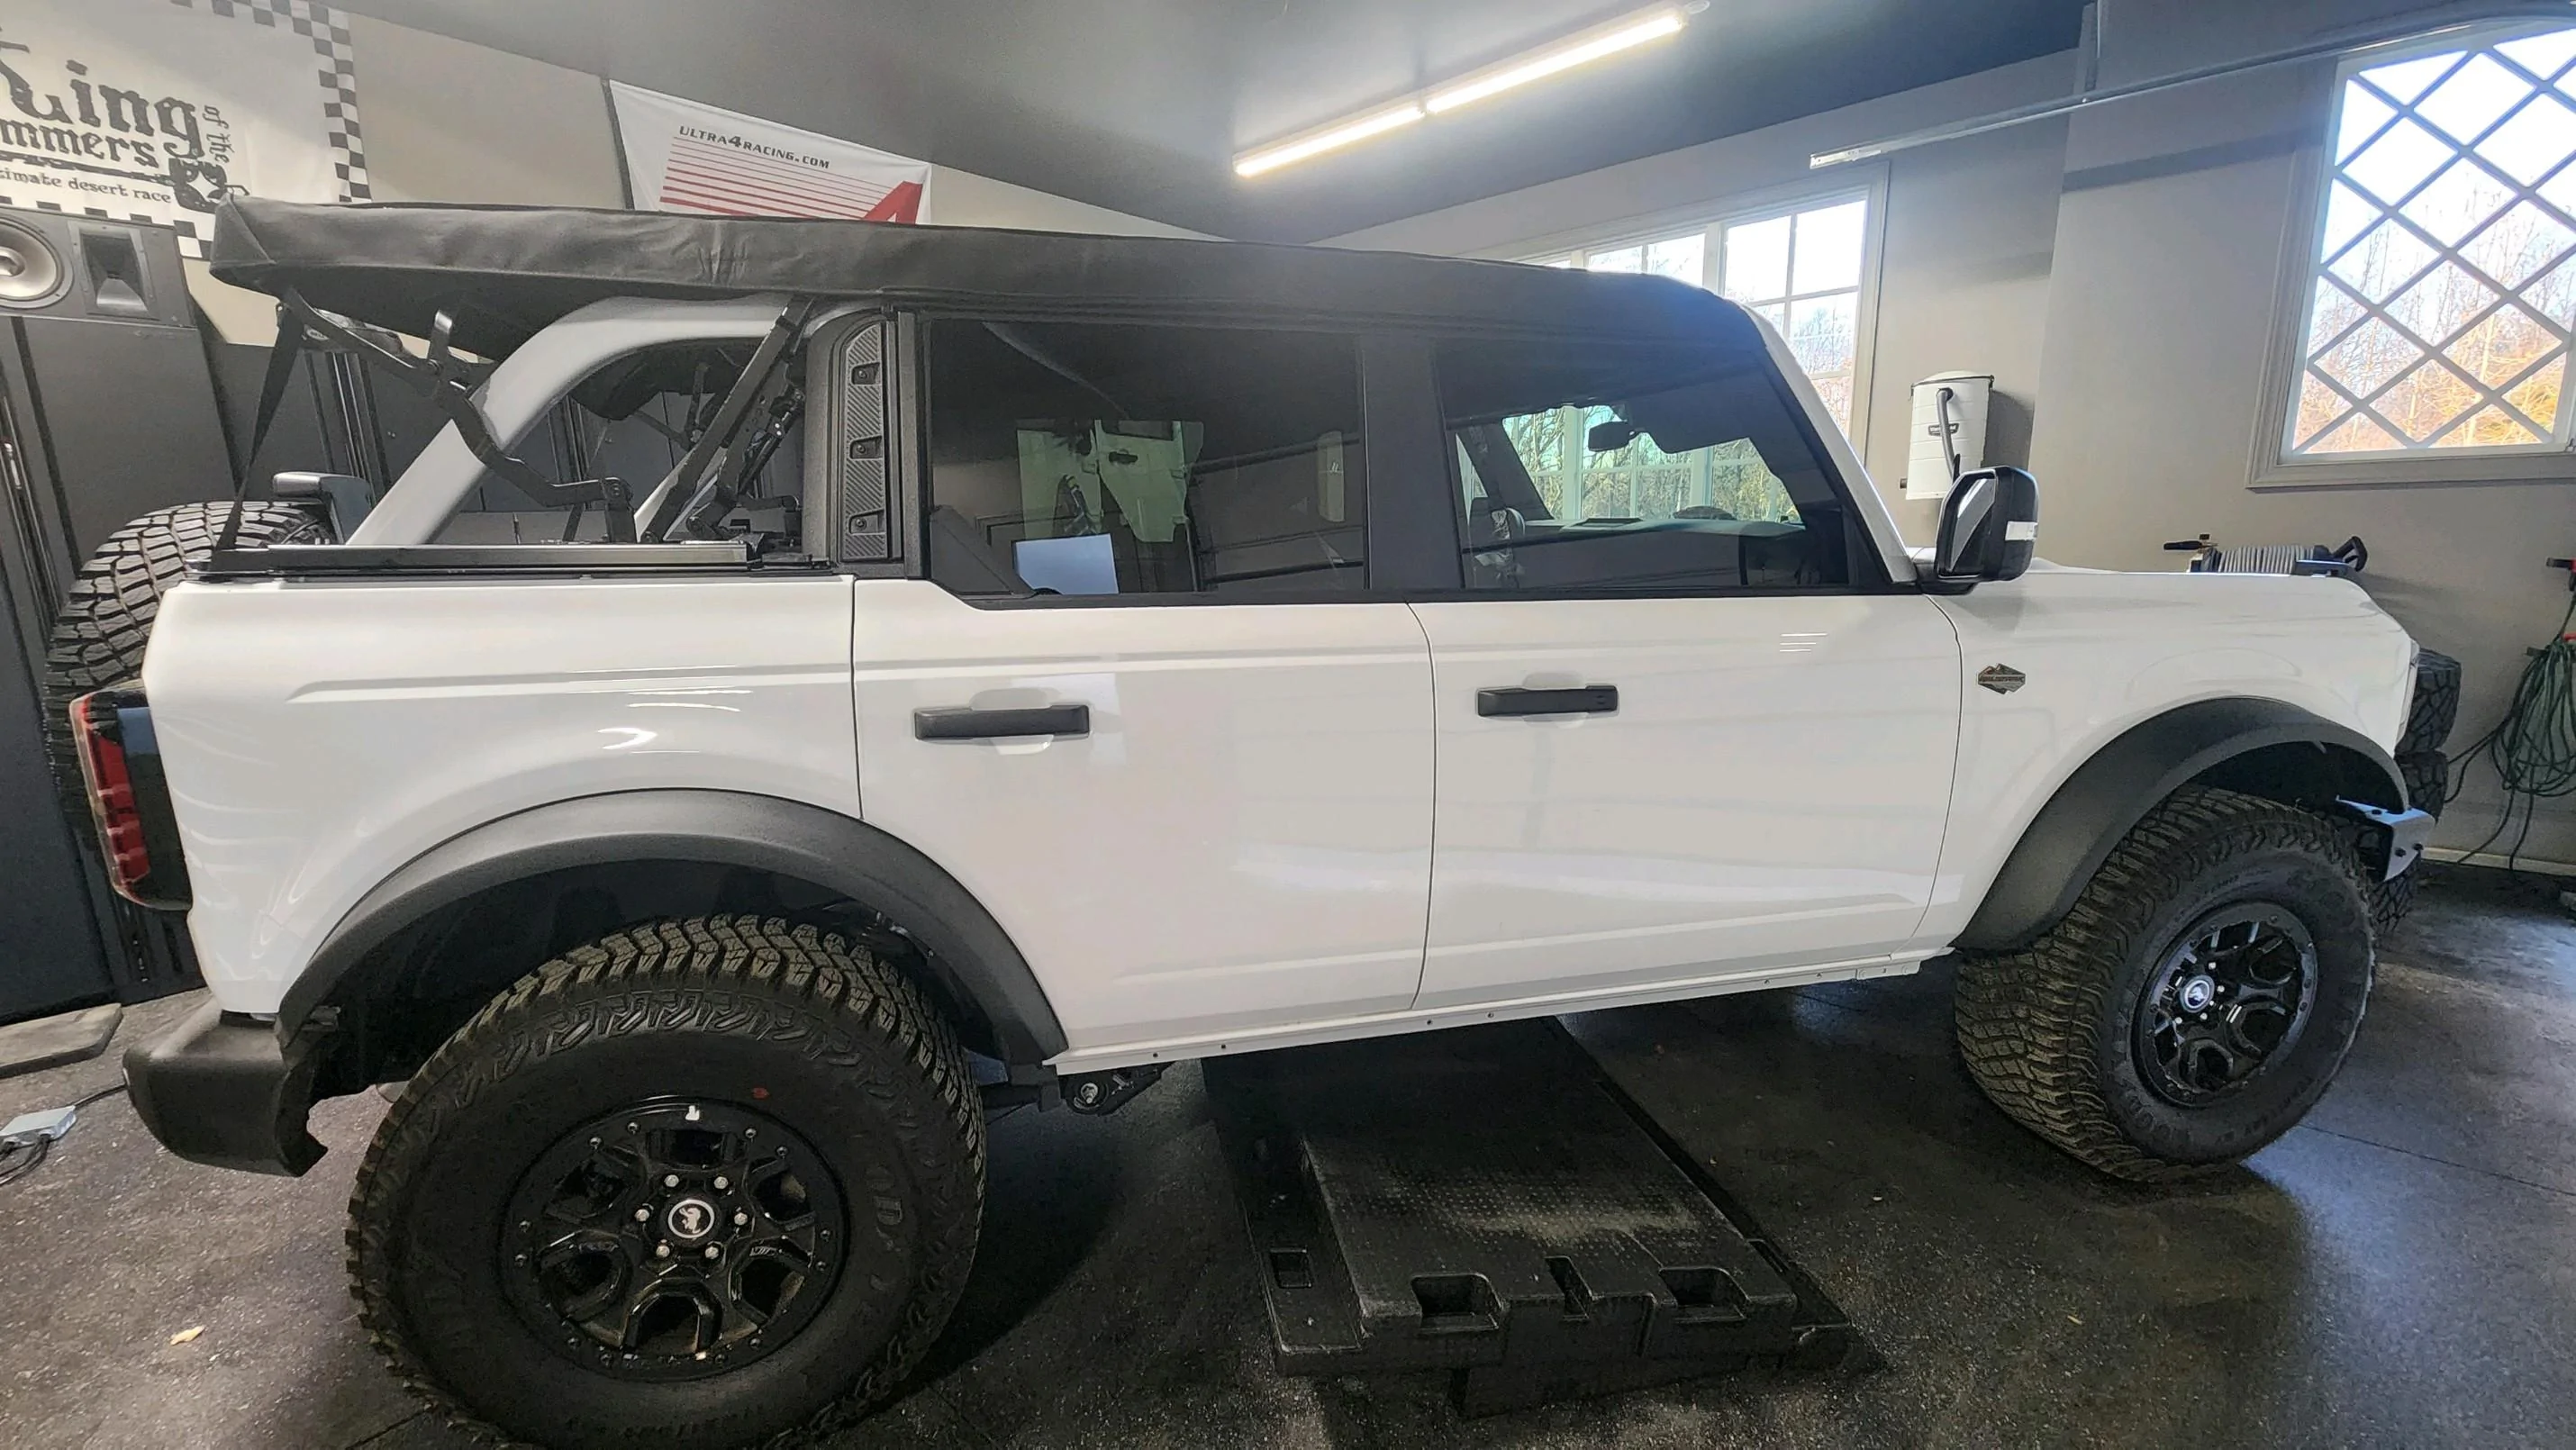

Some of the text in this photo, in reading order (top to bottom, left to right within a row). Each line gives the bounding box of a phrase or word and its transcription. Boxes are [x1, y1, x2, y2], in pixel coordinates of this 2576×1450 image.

[202, 104, 235, 163] of the
[679, 125, 830, 168] ULTRA4RACING.COM
[68, 177, 128, 197] desert
[133, 188, 171, 203] race
